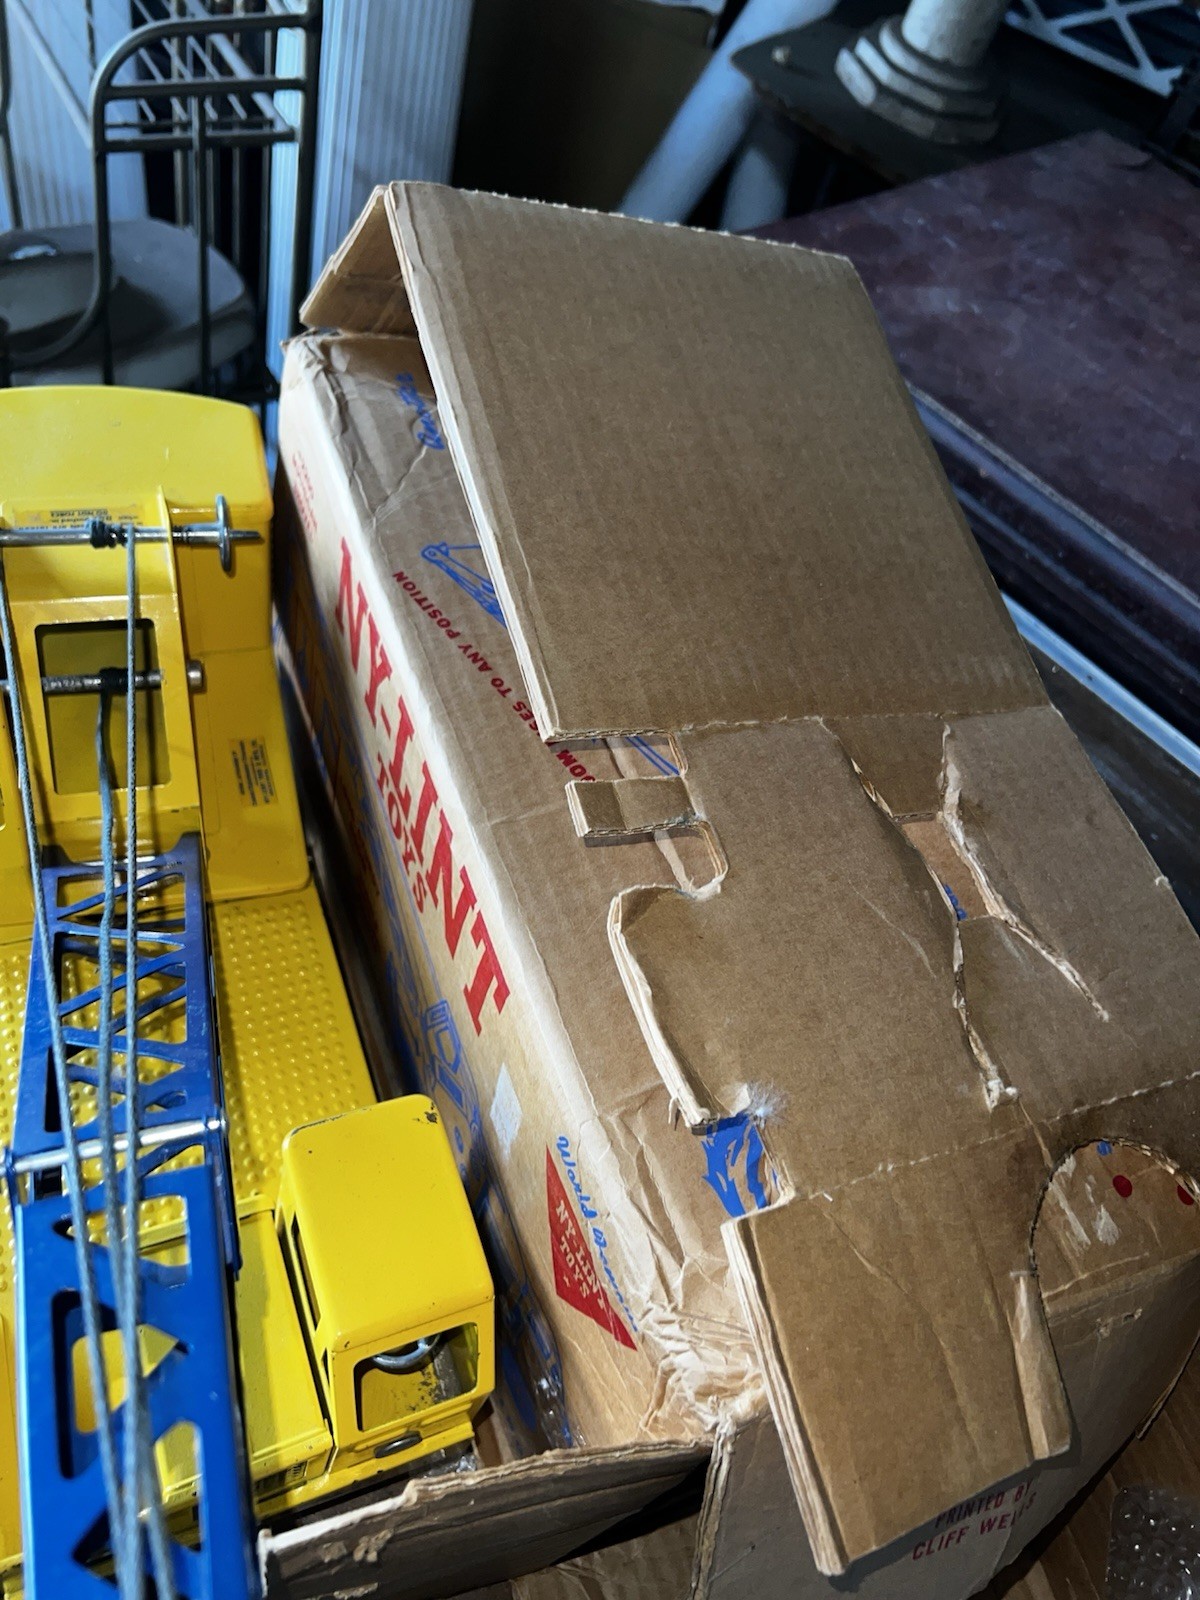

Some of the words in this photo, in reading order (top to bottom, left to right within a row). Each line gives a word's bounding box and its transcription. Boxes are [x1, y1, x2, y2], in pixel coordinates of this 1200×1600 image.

[393, 571, 461, 639] POSITION
[458, 643, 493, 673] ANY
[491, 676, 512, 698] TO
[336, 536, 511, 1037] NY-LINT
[376, 753, 427, 914] TOYS
[556, 1136, 597, 1219] World
[559, 1235, 590, 1299] TOYS
[935, 1491, 1005, 1528] PRINTED
[912, 1526, 970, 1561] CLIFF
